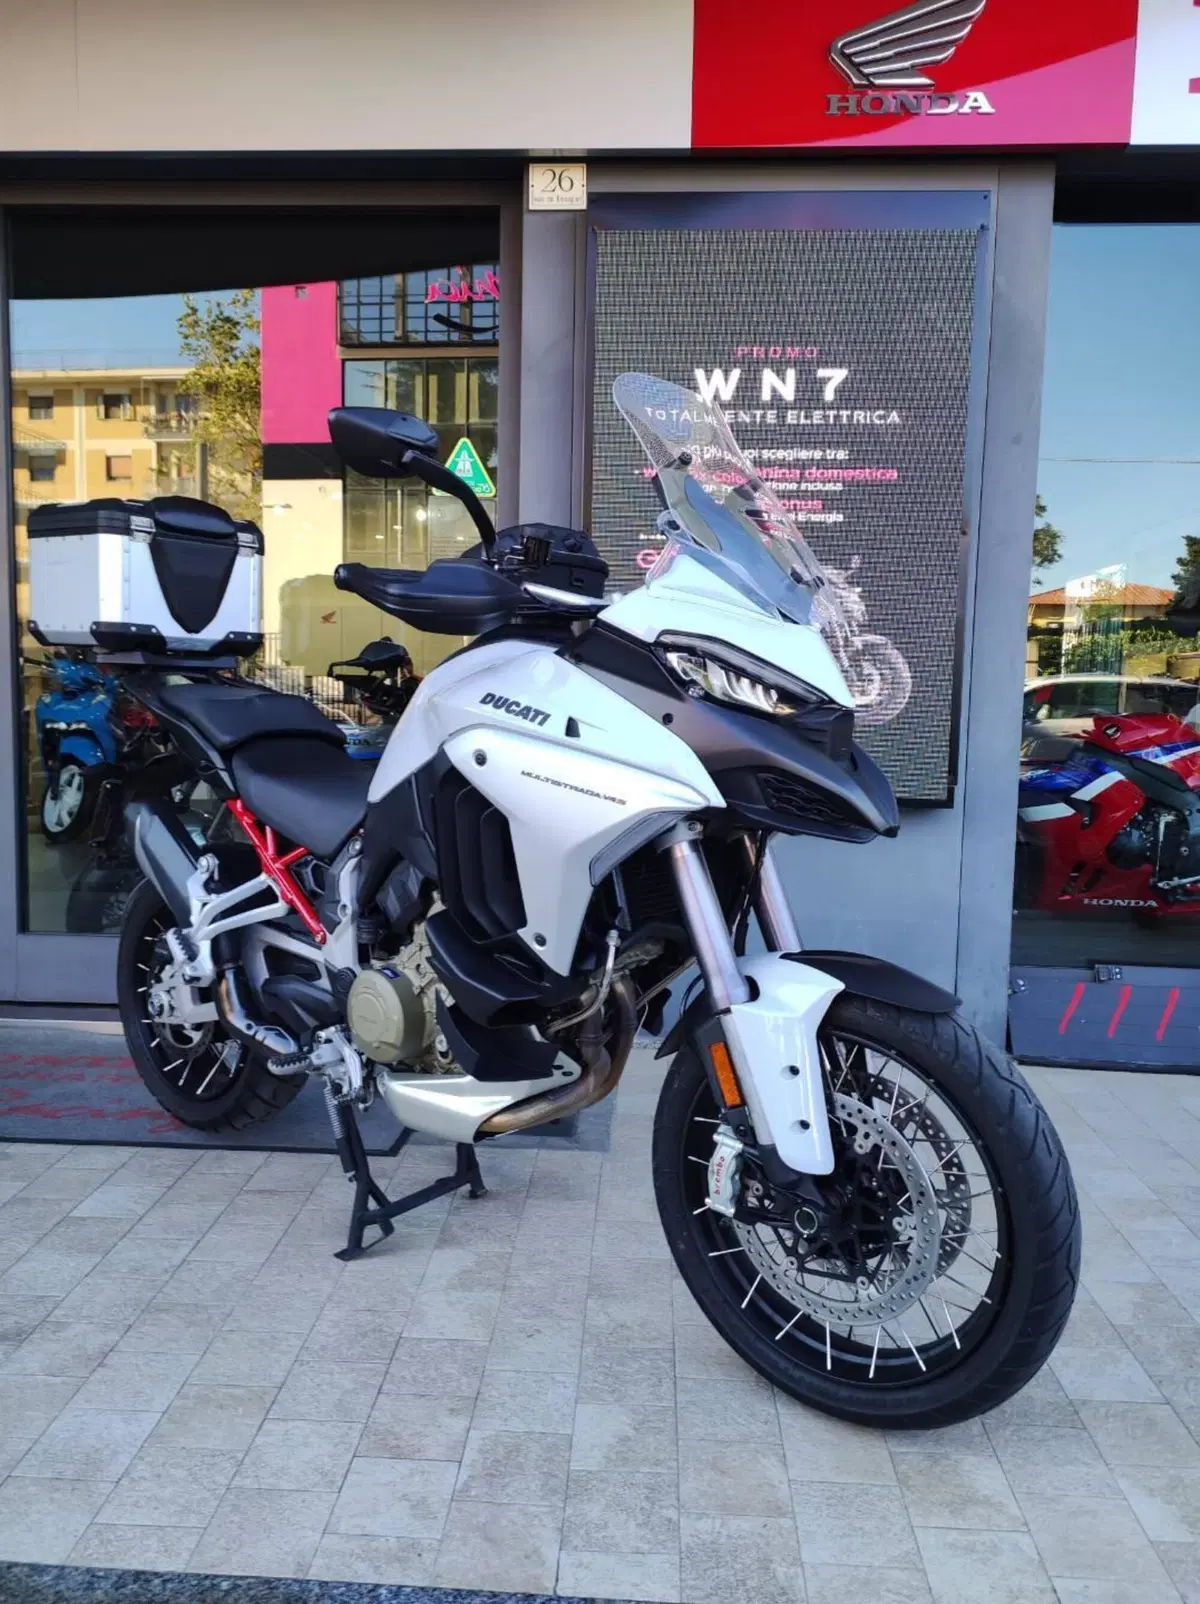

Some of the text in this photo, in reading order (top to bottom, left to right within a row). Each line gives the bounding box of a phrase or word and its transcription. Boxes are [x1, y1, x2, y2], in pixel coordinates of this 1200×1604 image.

[825, 91, 996, 116] HONDA
[541, 168, 574, 193] 26
[786, 410, 901, 425] ELETTRICA
[762, 448, 822, 461] scegliere
[805, 466, 898, 480] domestica
[479, 692, 552, 727] DUCATI
[1083, 898, 1159, 908] HONDA
[714, 1156, 725, 1195] brembo
